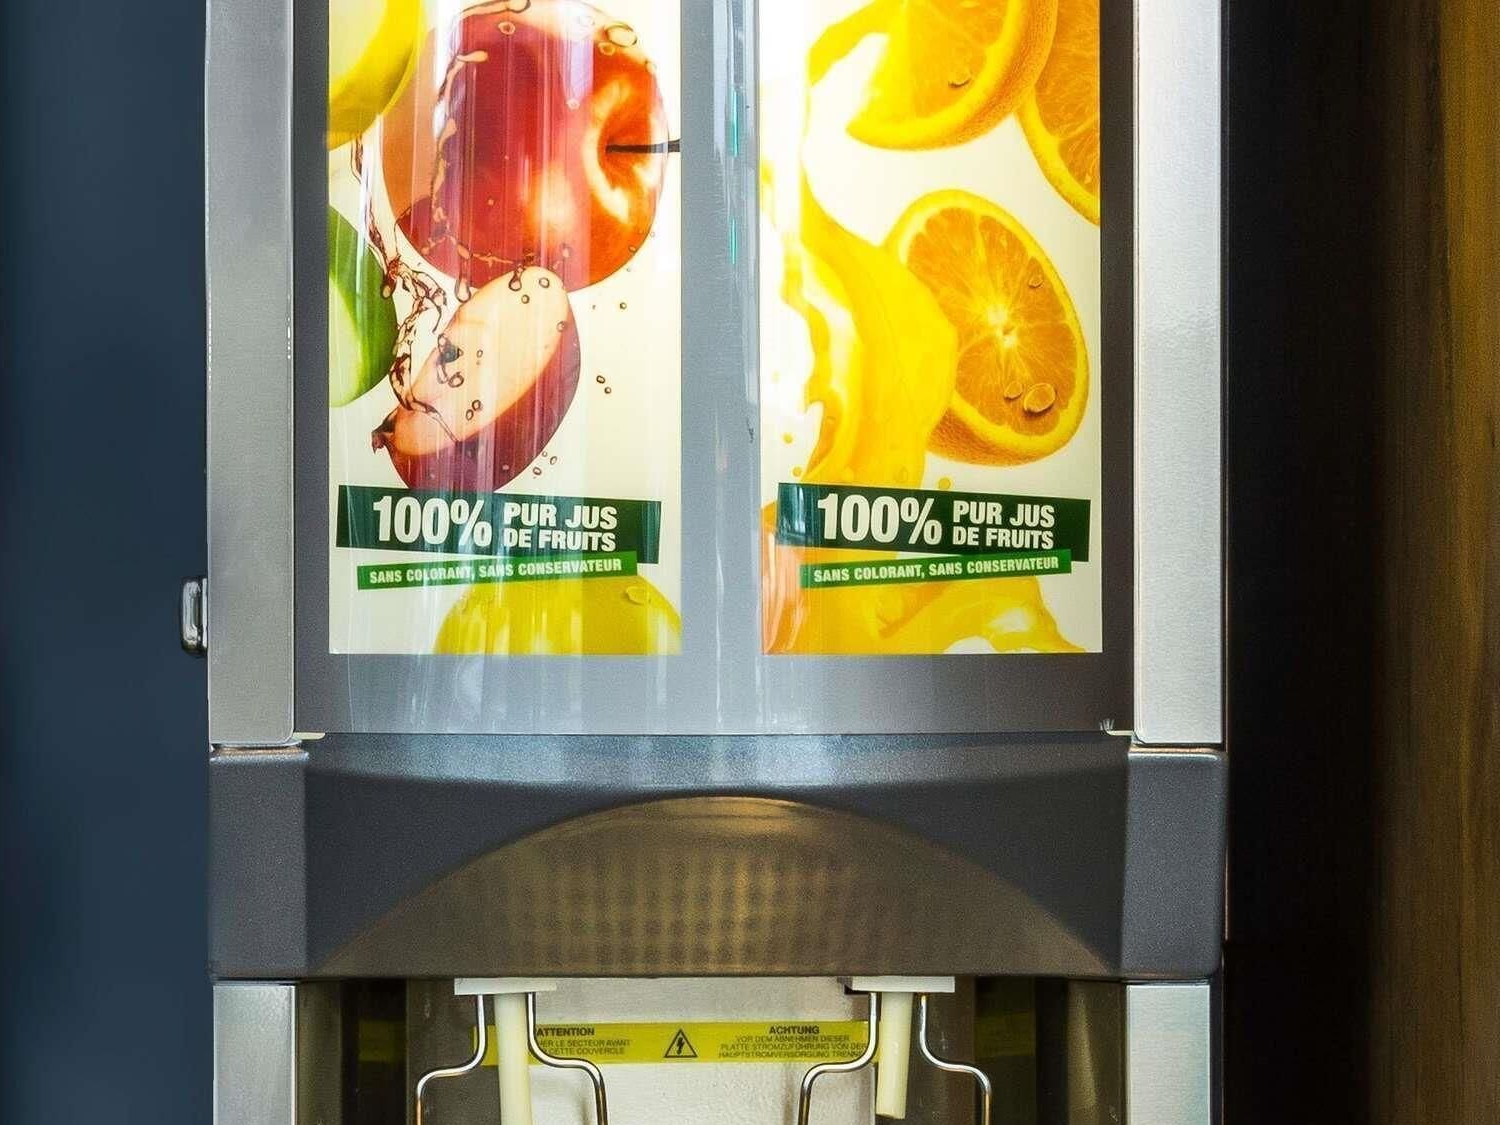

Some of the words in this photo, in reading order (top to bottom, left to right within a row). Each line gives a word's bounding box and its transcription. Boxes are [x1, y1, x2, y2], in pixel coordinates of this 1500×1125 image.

[373, 495, 493, 547] 100%
[503, 501, 557, 527] PUR
[565, 504, 618, 530] JUS
[817, 492, 943, 545] 100%
[952, 499, 1004, 525] PUR
[1009, 502, 1056, 528] JUS
[501, 527, 532, 548] DE
[538, 529, 617, 552] FRUITS
[952, 525, 980, 546] DE
[985, 527, 1055, 550] FRUITS
[369, 569, 403, 584] SANS
[405, 564, 476, 583] COLORANT,
[478, 564, 515, 579] SANS
[517, 558, 623, 577] CONSERVATEUR
[813, 567, 851, 583] SANS
[853, 563, 926, 580] COLORANT,
[928, 561, 963, 576] SANS
[966, 556, 1060, 574] CONSERVATEUR
[536, 1027, 595, 1037] ATTENTION
[769, 1025, 820, 1035] ACHTUNG
[605, 1039, 631, 1047] AVANT
